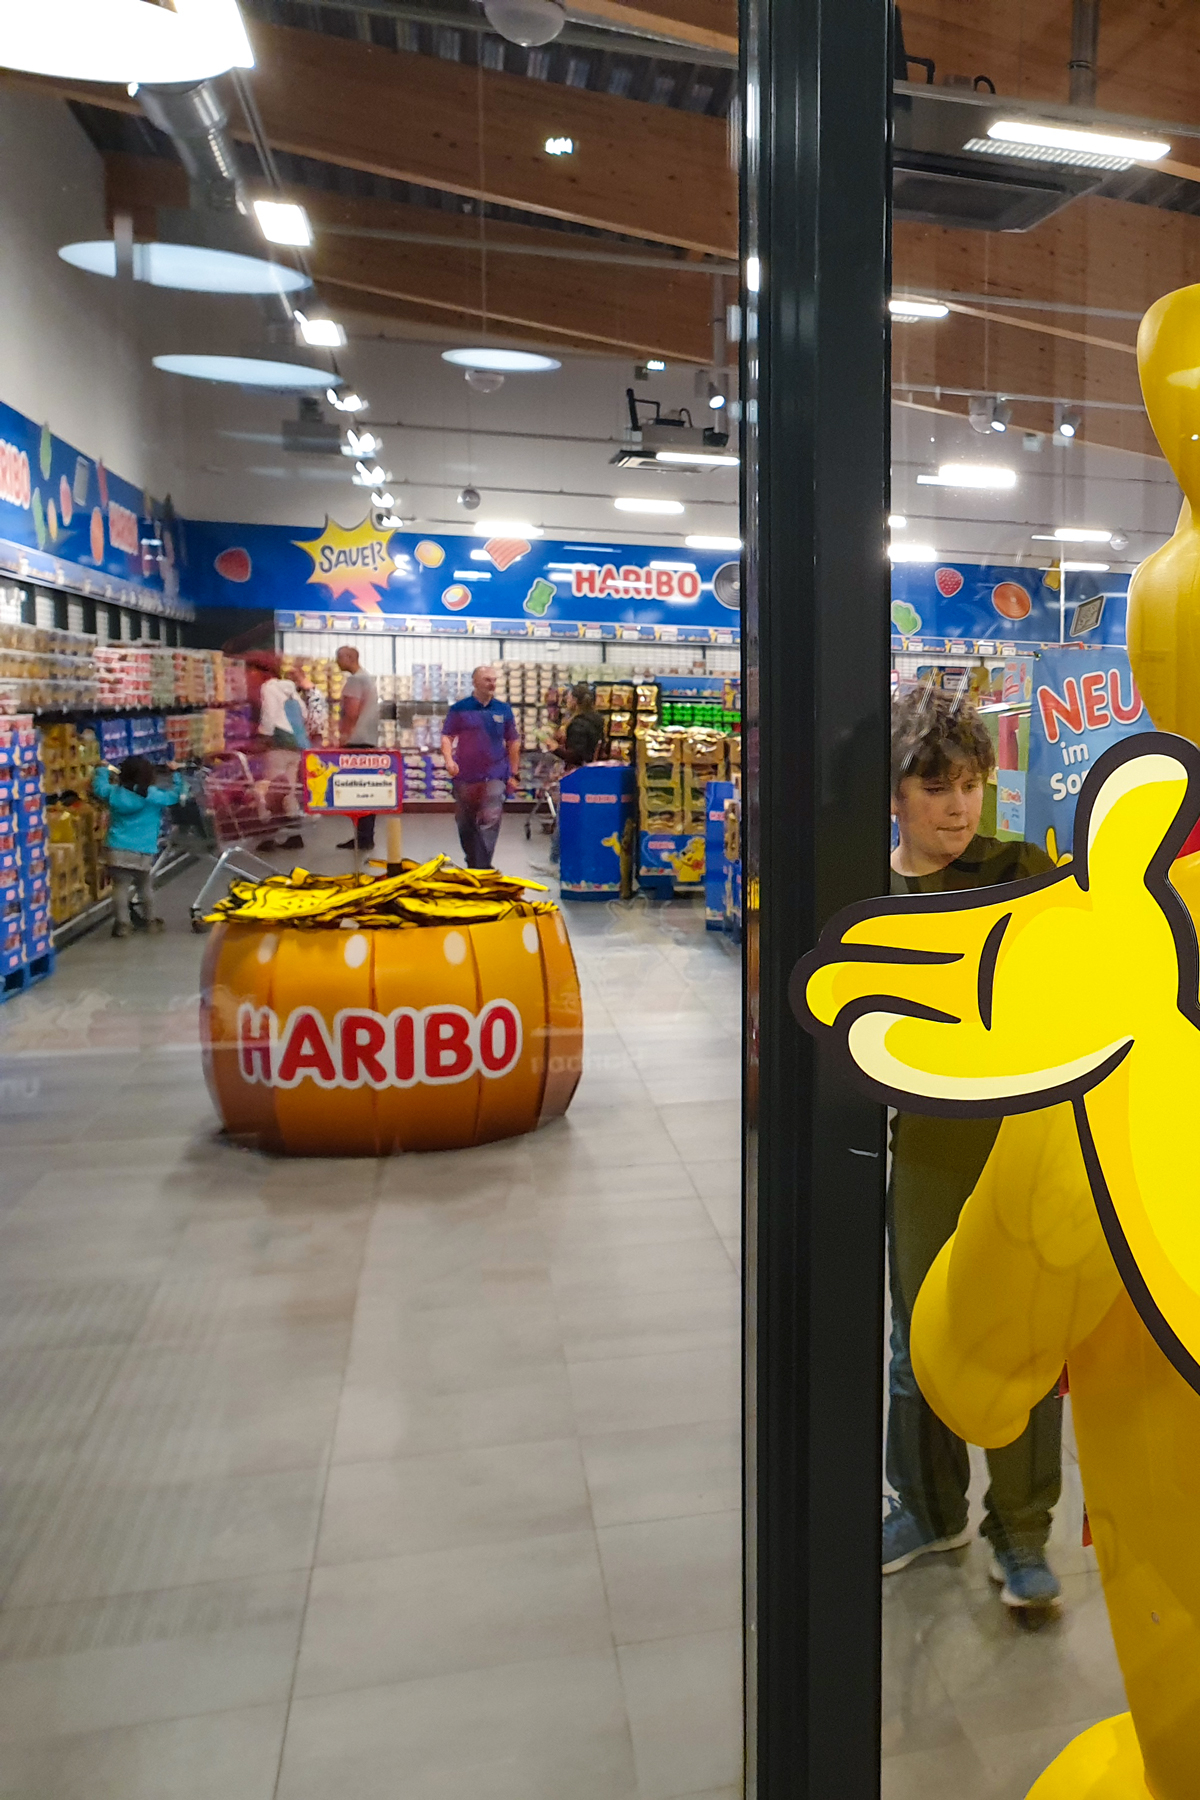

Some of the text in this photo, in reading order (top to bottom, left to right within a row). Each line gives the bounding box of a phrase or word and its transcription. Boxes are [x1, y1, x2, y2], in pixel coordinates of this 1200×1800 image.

[573, 565, 701, 600] HARIBO
[1037, 669, 1143, 743] NEU
[1060, 741, 1089, 766] im
[1050, 770, 1089, 800] So
[239, 998, 523, 1089] HARIBO
